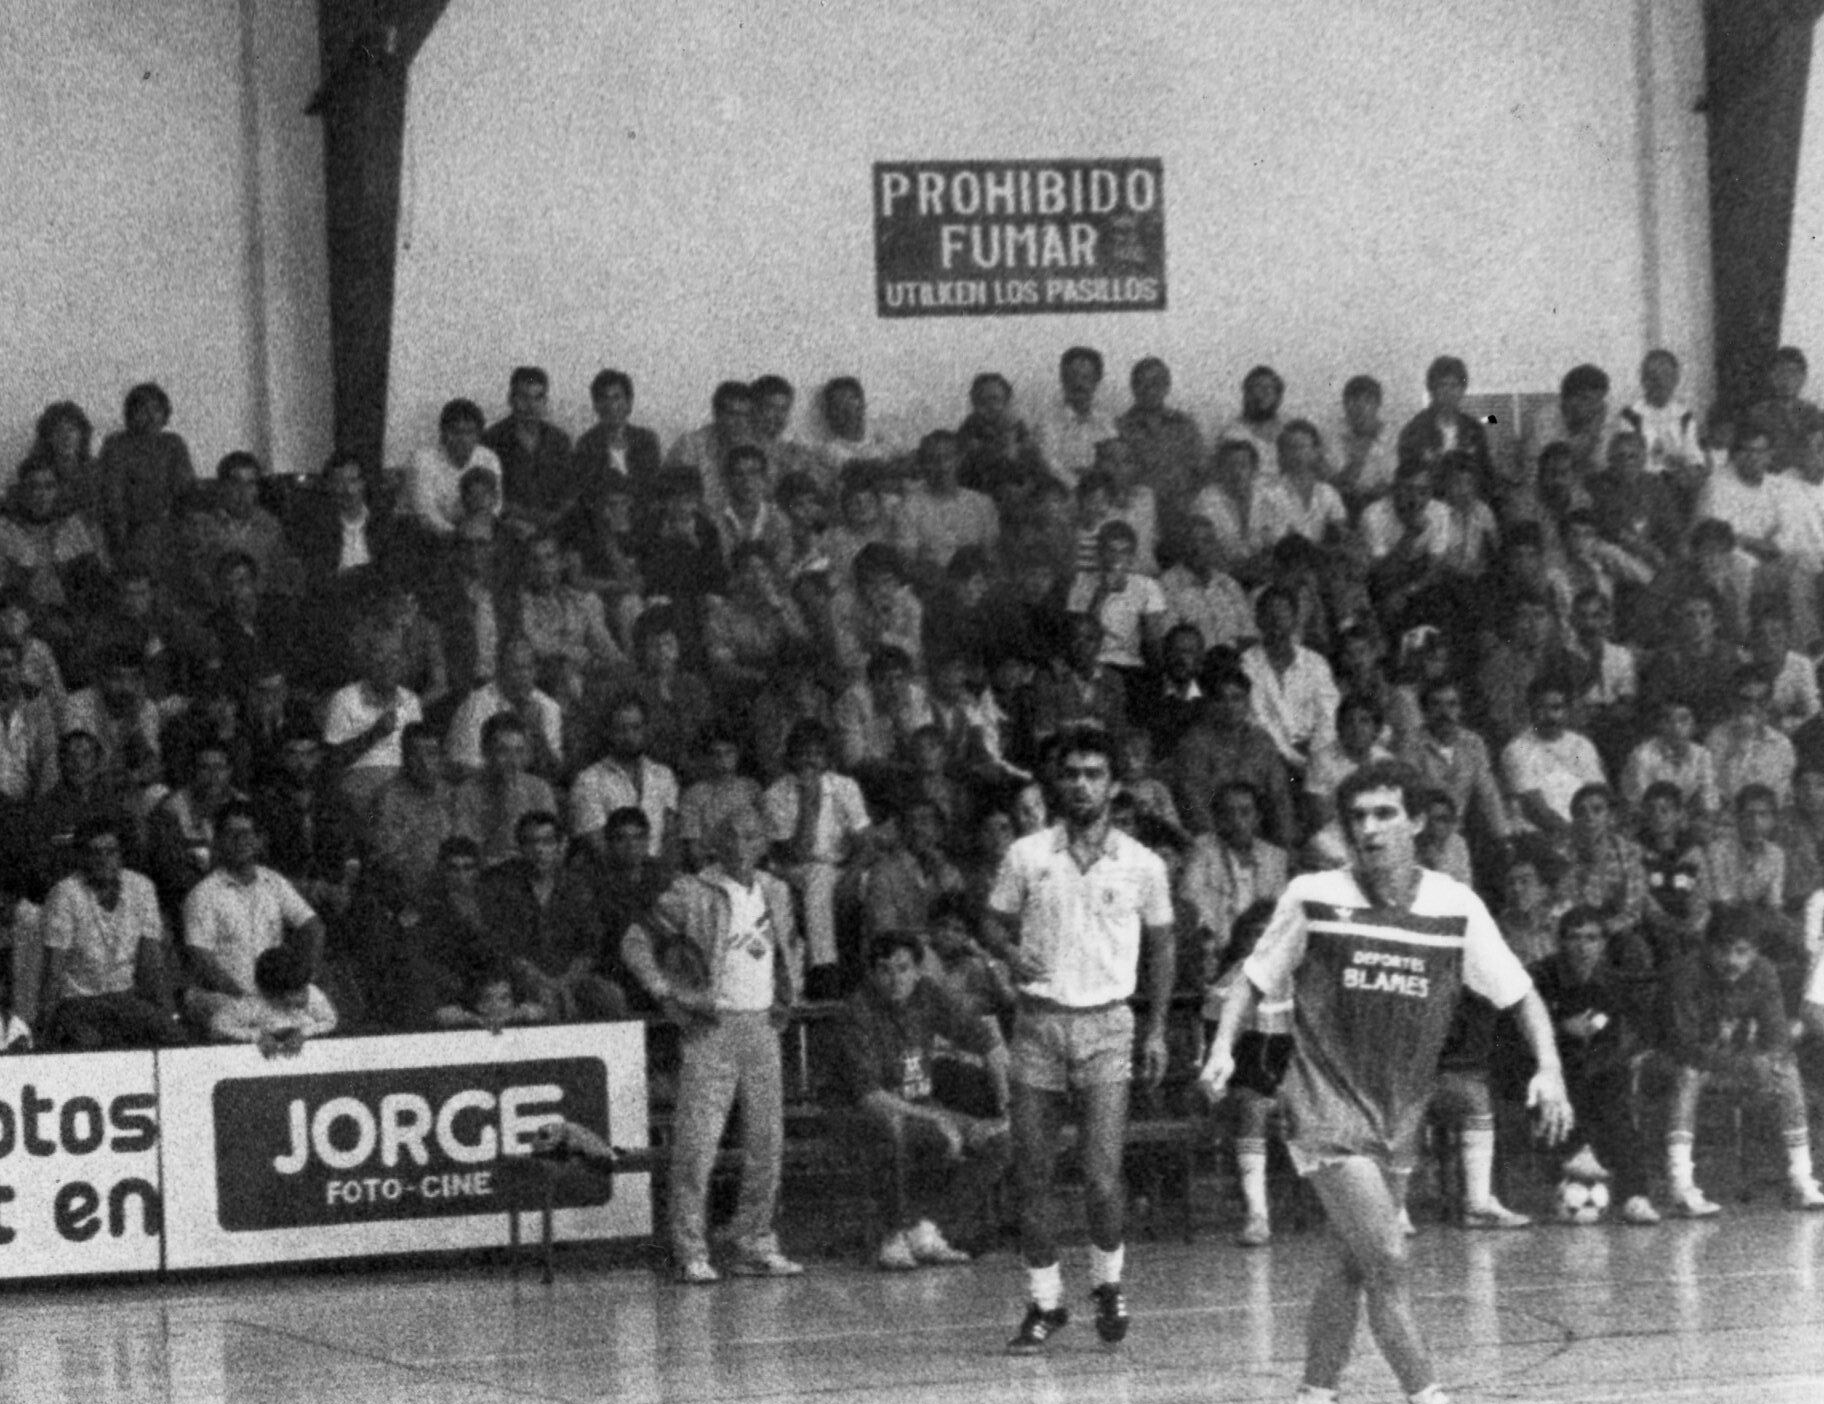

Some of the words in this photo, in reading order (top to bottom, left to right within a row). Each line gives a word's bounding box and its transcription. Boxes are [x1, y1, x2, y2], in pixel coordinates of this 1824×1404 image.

[881, 168, 1156, 217] PROHIBIDO
[940, 223, 1098, 269] FUMAR
[993, 279, 1040, 304] LOS
[272, 1083, 565, 1176] JORGE
[53, 1176, 162, 1244] en
